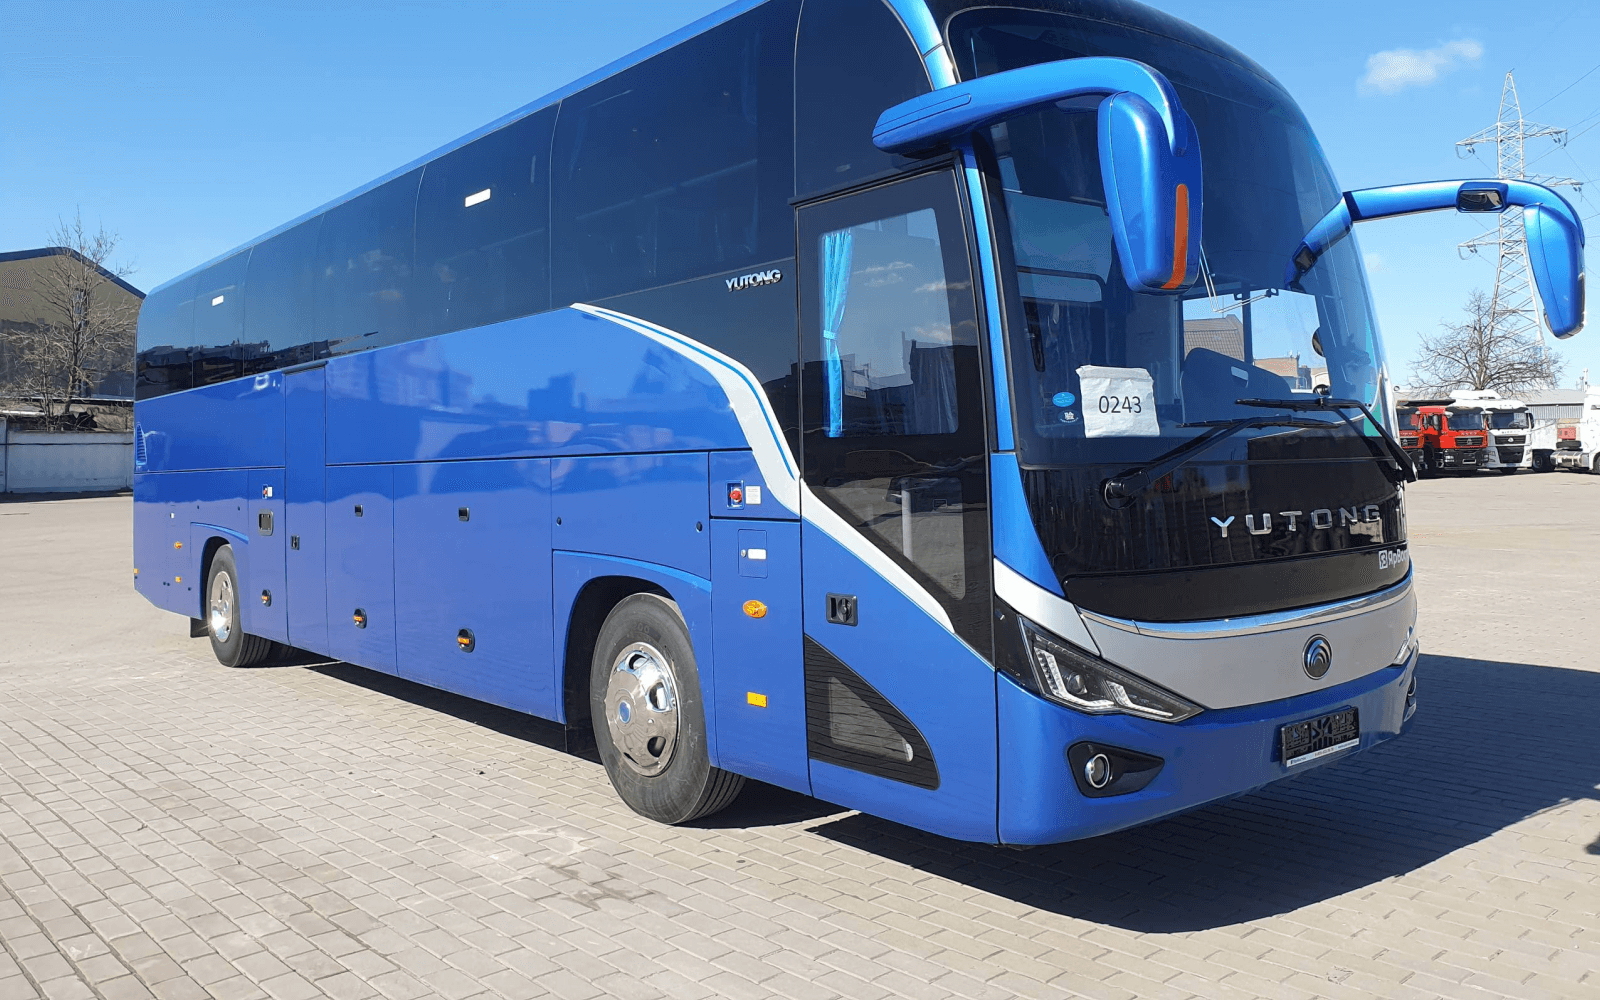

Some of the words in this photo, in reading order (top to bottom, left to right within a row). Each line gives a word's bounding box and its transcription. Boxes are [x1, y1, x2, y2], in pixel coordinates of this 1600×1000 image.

[725, 269, 782, 292] YUTONG
[1098, 395, 1142, 414] 0243
[1210, 504, 1381, 538] YUTONG
